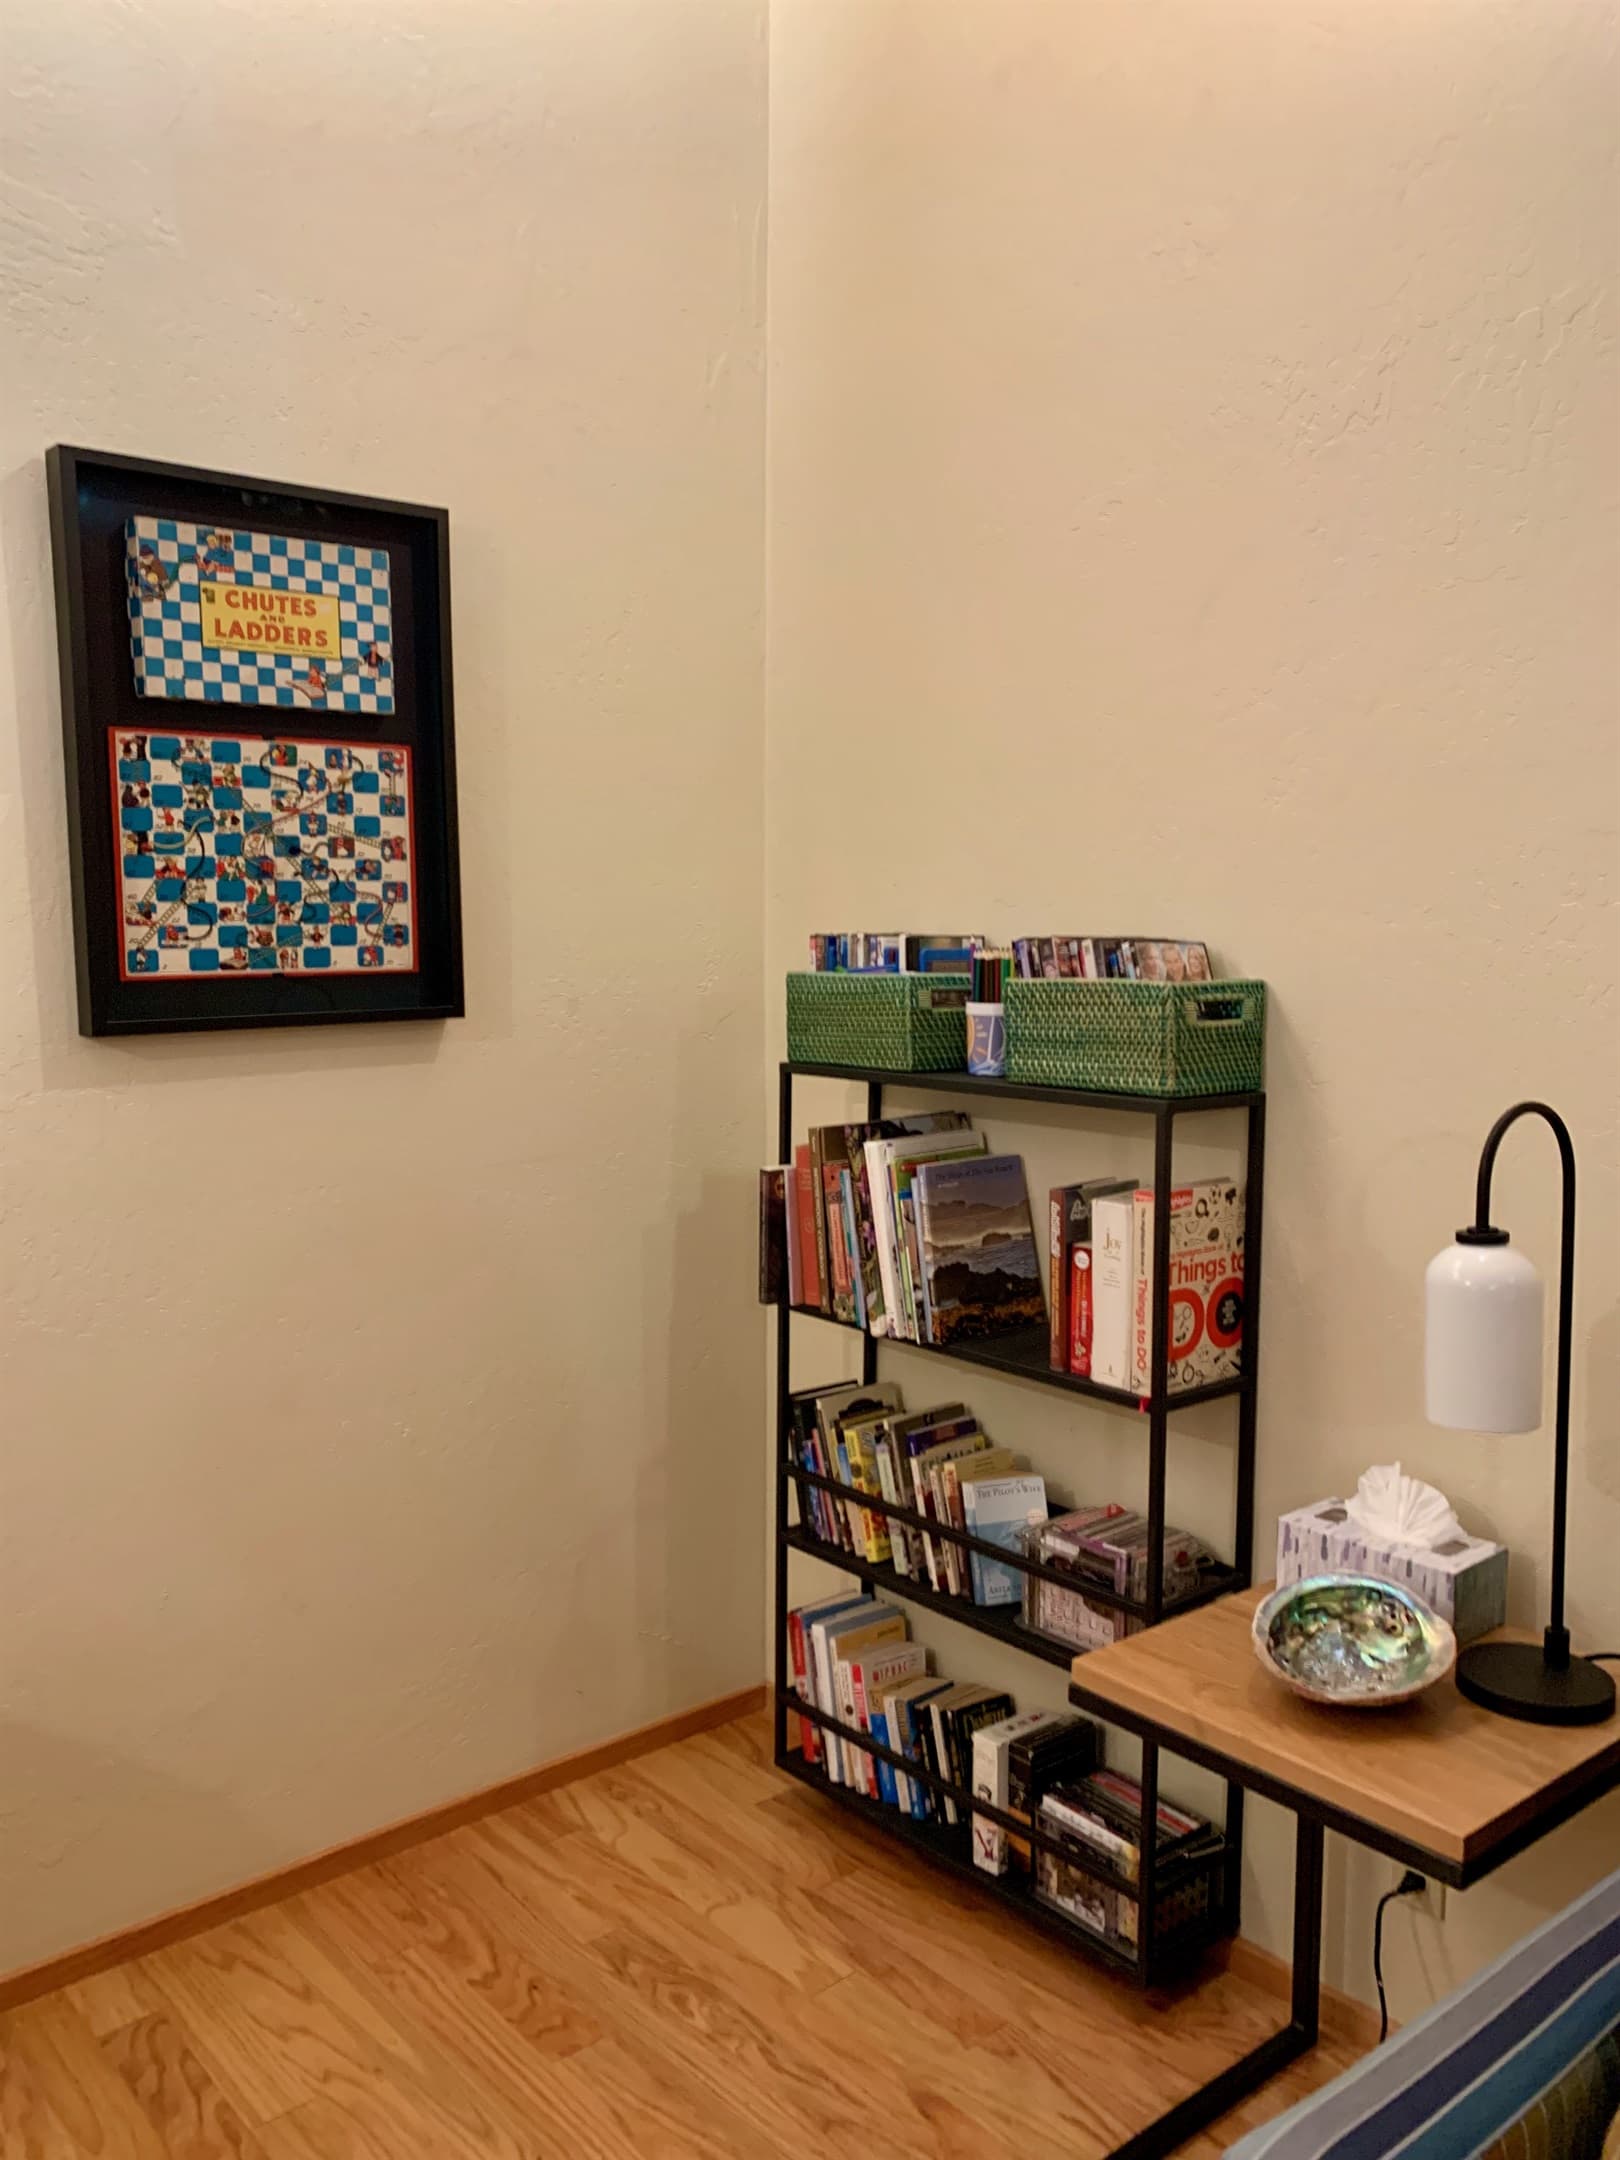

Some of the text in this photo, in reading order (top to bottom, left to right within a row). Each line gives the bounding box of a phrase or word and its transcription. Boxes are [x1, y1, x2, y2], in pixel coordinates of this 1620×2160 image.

[225, 589, 317, 617] CHUTES
[214, 617, 328, 648] LADDERS
[260, 613, 286, 624] AND
[1135, 1279, 1148, 1326] Things
[1168, 1276, 1244, 1364] DO
[1136, 1330, 1147, 1344] to
[1137, 1347, 1148, 1370] DO
